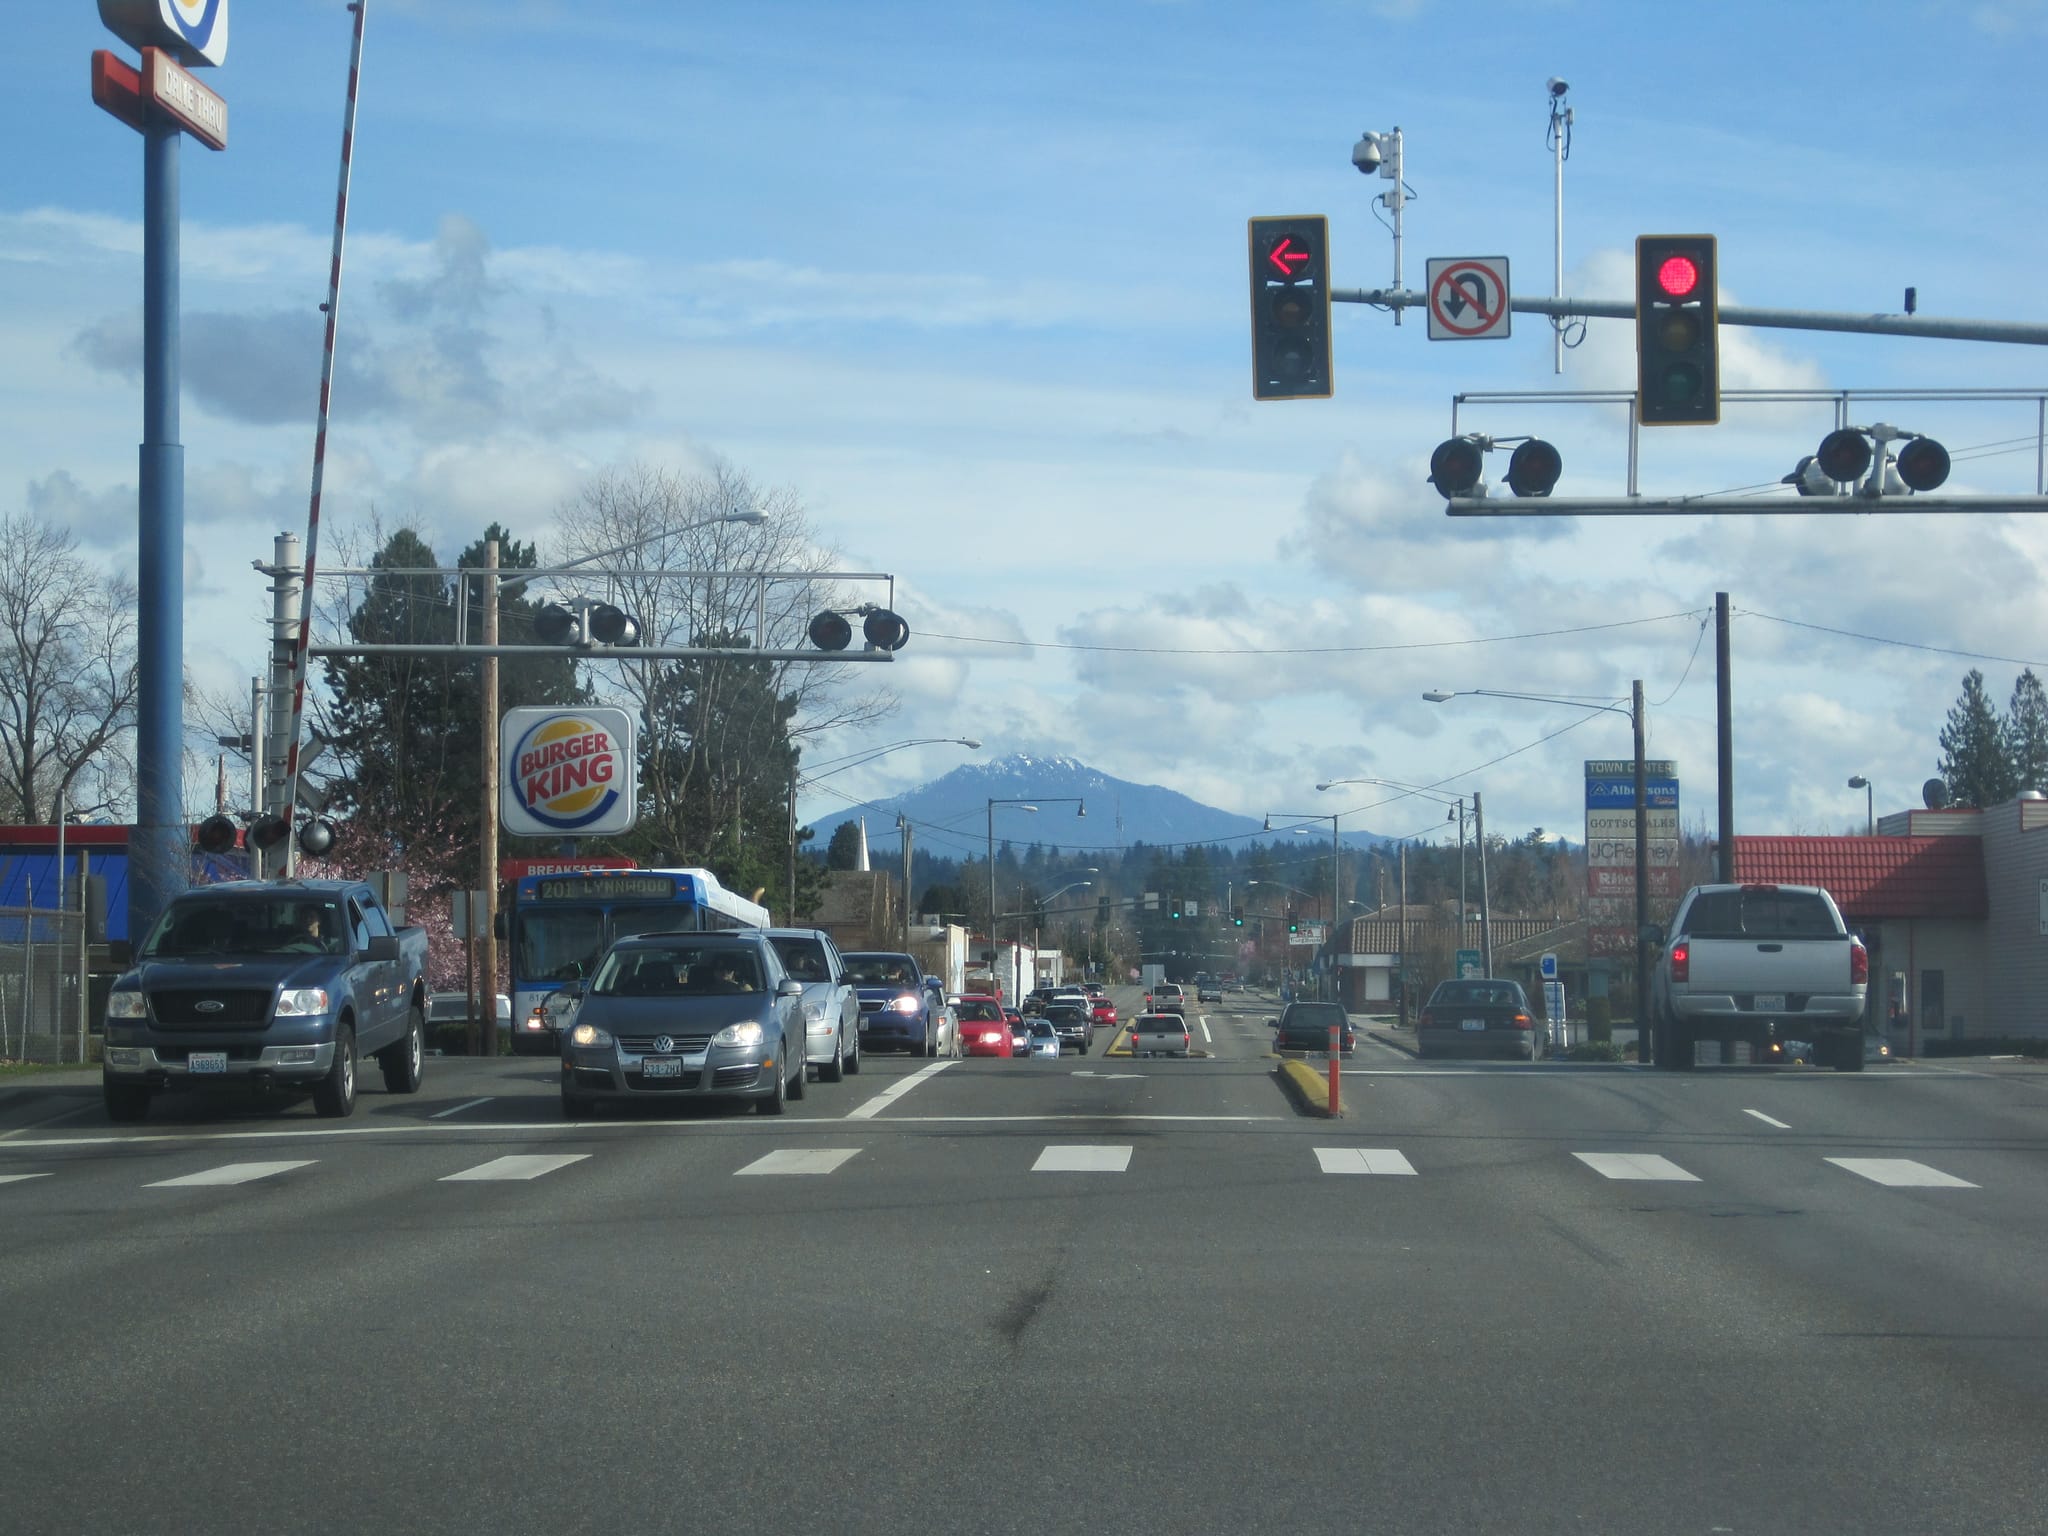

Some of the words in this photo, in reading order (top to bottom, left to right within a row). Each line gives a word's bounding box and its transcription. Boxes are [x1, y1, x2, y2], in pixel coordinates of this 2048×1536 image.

[166, 66, 193, 112] DRIVE
[197, 90, 222, 132] THRU
[521, 733, 608, 778] BURGER
[1590, 762, 1623, 773] TOWN
[1627, 762, 1672, 773] CNTER
[527, 754, 613, 806] KING
[1610, 785, 1676, 795] Albsons
[1590, 819, 1676, 828] GOTTSCALKS
[1591, 843, 1674, 862] JCPeney
[543, 882, 575, 898] 201
